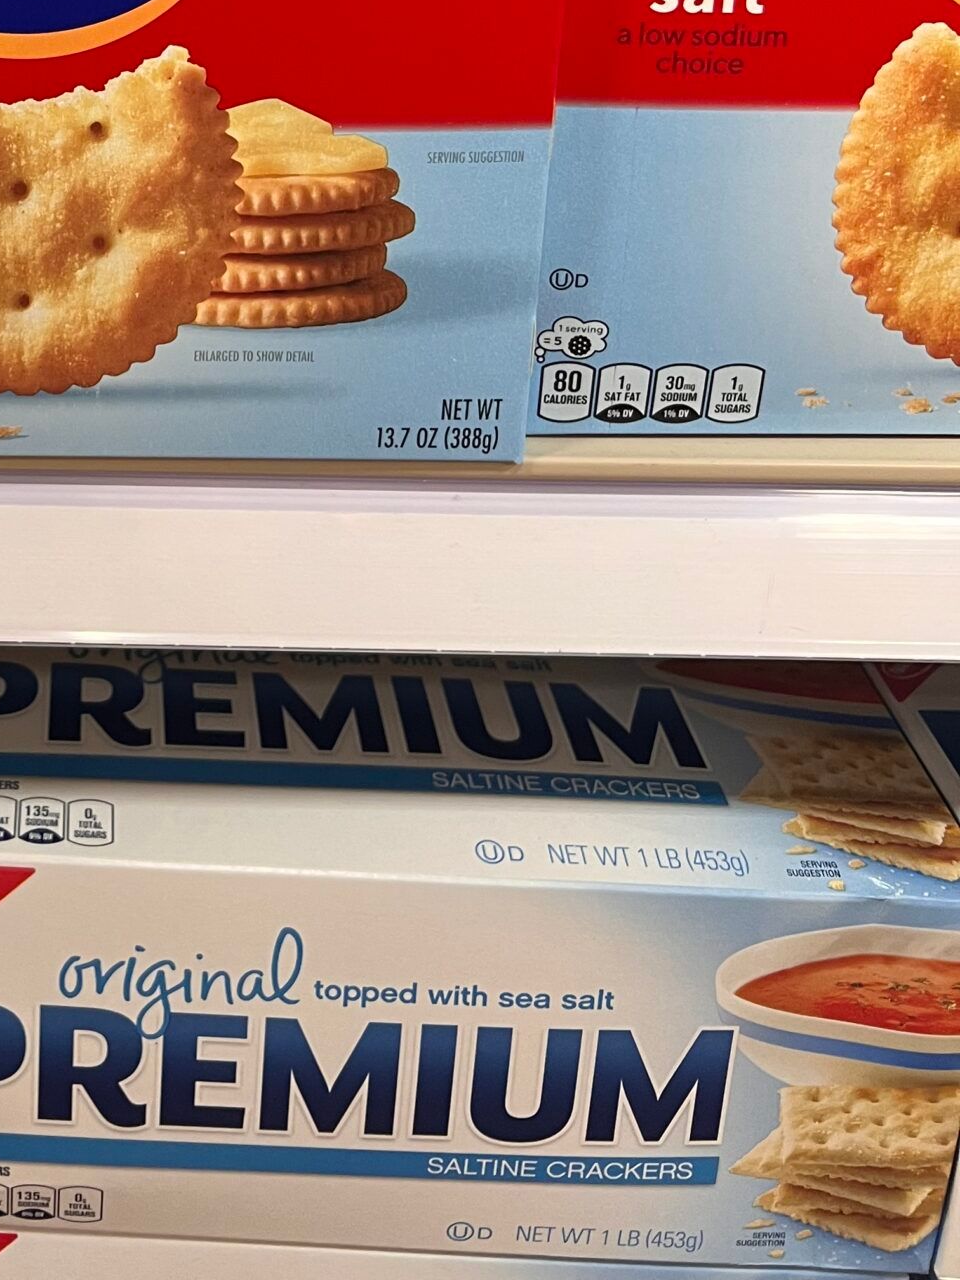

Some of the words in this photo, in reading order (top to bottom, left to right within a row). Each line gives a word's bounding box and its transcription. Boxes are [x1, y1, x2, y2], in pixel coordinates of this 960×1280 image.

[617, 28, 632, 46] a
[639, 24, 687, 47] low
[691, 25, 789, 48] sodium
[655, 51, 745, 75] choice
[427, 151, 465, 164] SERVING
[468, 150, 524, 164] SUGGESTION
[194, 350, 239, 363] ENLARGED
[242, 350, 254, 363] TO
[256, 350, 283, 363] SHOW
[285, 350, 315, 363] DETAIL
[553, 370, 582, 392] 80
[543, 394, 588, 405] CALORIES
[604, 392, 621, 402] SAT
[624, 392, 641, 402] FAT
[660, 392, 697, 402] SODIUM
[721, 392, 748, 402] TOTAL
[440, 399, 473, 421] NET
[476, 399, 503, 421] WT
[714, 404, 751, 414] SUGARS
[376, 427, 410, 448] 13.7
[416, 427, 439, 449] OZ
[444, 427, 499, 454] (388g)
[432, 771, 540, 793] SALTINE
[550, 775, 700, 800] CRACKERS
[547, 844, 588, 865] NET
[592, 846, 632, 868] WT
[638, 848, 648, 868] 1
[655, 848, 682, 869] LB
[686, 847, 751, 876] (453g)
[800, 860, 838, 869] SERVING
[786, 869, 841, 878] SUGGESTION
[59, 926, 302, 1039] original
[314, 980, 418, 1009] topped
[427, 985, 488, 1008] with
[499, 990, 551, 1009] sea
[561, 989, 615, 1011] salt
[427, 1157, 538, 1177] SALTINE
[546, 1161, 693, 1181] CRACKERS
[516, 1225, 556, 1243] NET
[562, 1227, 597, 1245] WT
[602, 1229, 610, 1245] 1
[617, 1230, 640, 1246] LB
[645, 1230, 704, 1252] (453g)
[736, 1239, 786, 1247] SUGGESTION
[752, 1232, 786, 1240] SERVING
